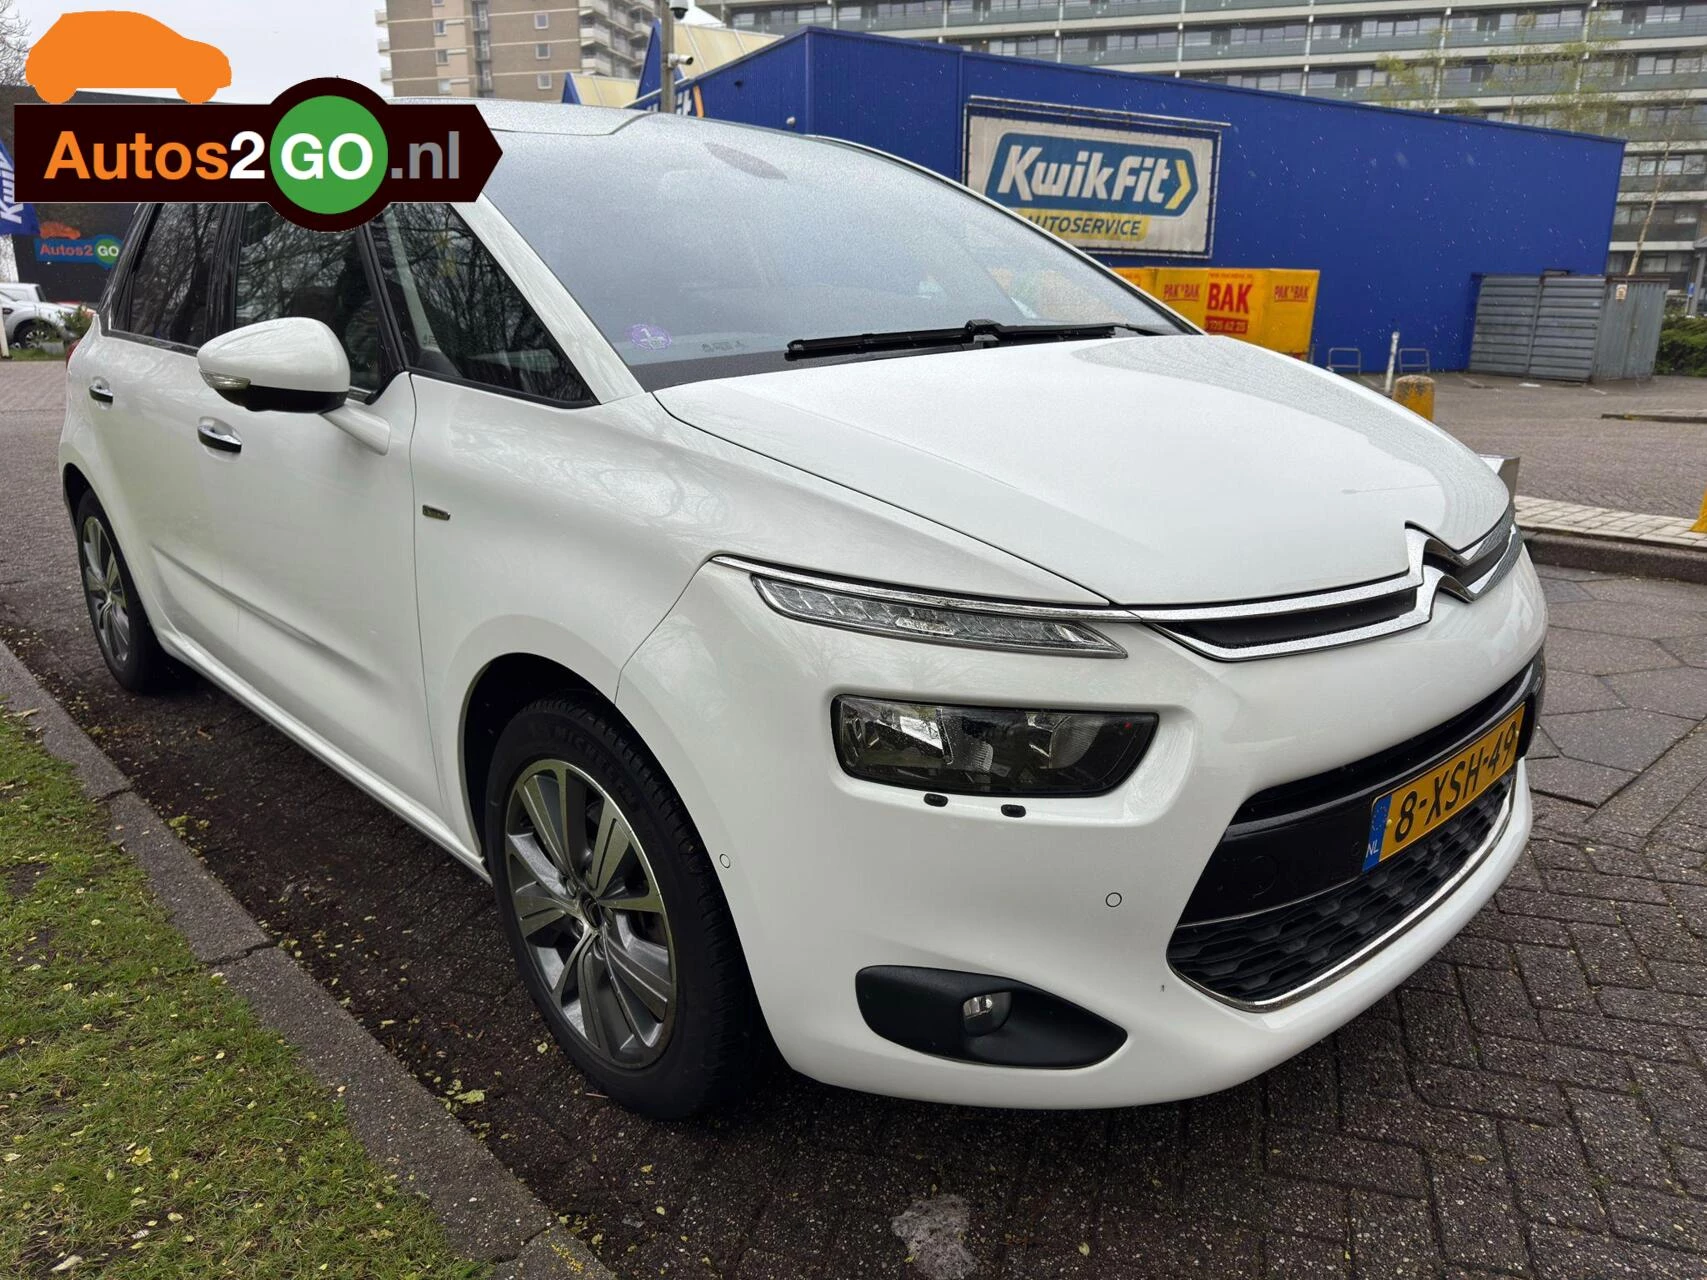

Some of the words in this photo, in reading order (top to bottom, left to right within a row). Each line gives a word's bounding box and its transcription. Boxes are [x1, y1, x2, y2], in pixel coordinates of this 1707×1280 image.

[1207, 283, 1254, 314] BAK
[1394, 721, 1517, 843] 8-XSH-49
[1365, 840, 1380, 859] NL
